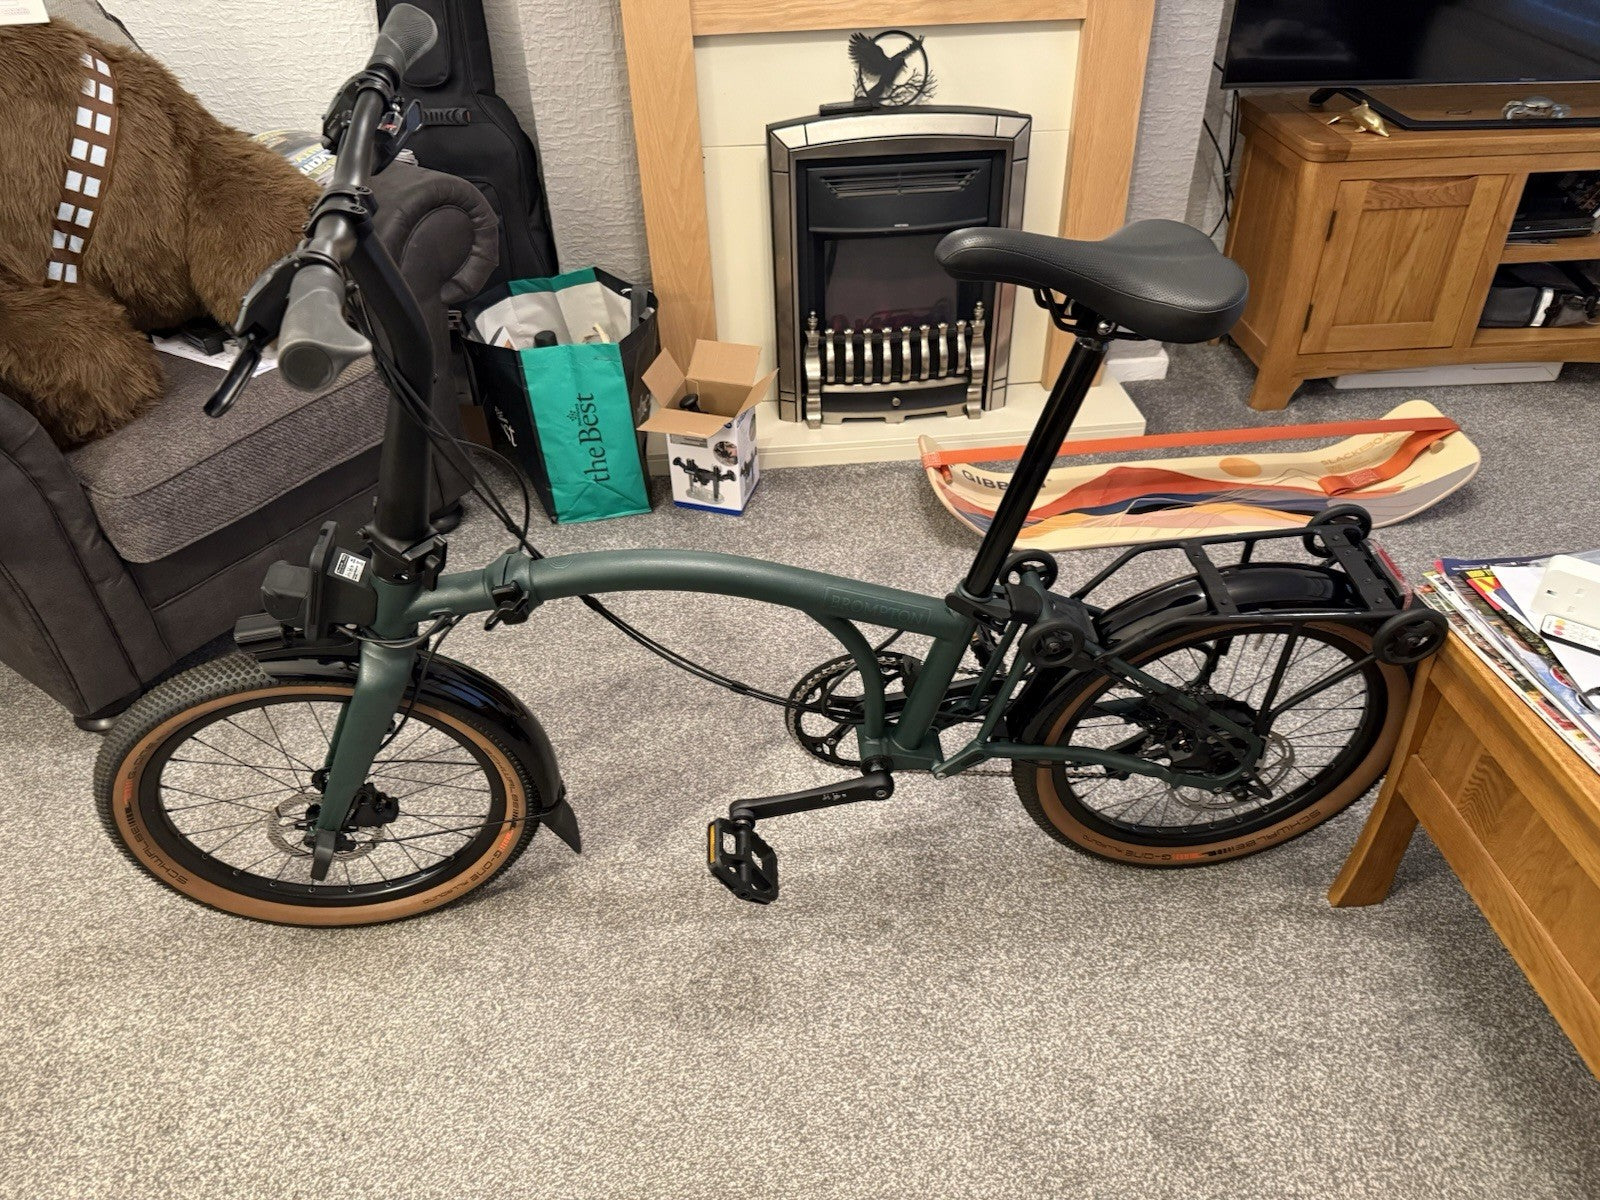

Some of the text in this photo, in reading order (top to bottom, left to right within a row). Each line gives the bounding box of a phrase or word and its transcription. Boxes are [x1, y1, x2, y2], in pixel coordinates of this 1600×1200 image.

[1320, 432, 1391, 467] SLACKBOA
[832, 594, 925, 625] BROMPTON
[1235, 808, 1321, 852] SCHWALBE
[130, 824, 188, 885] SCHWALBE
[470, 849, 502, 882] G-ONE
[1125, 848, 1172, 861] G-ONE
